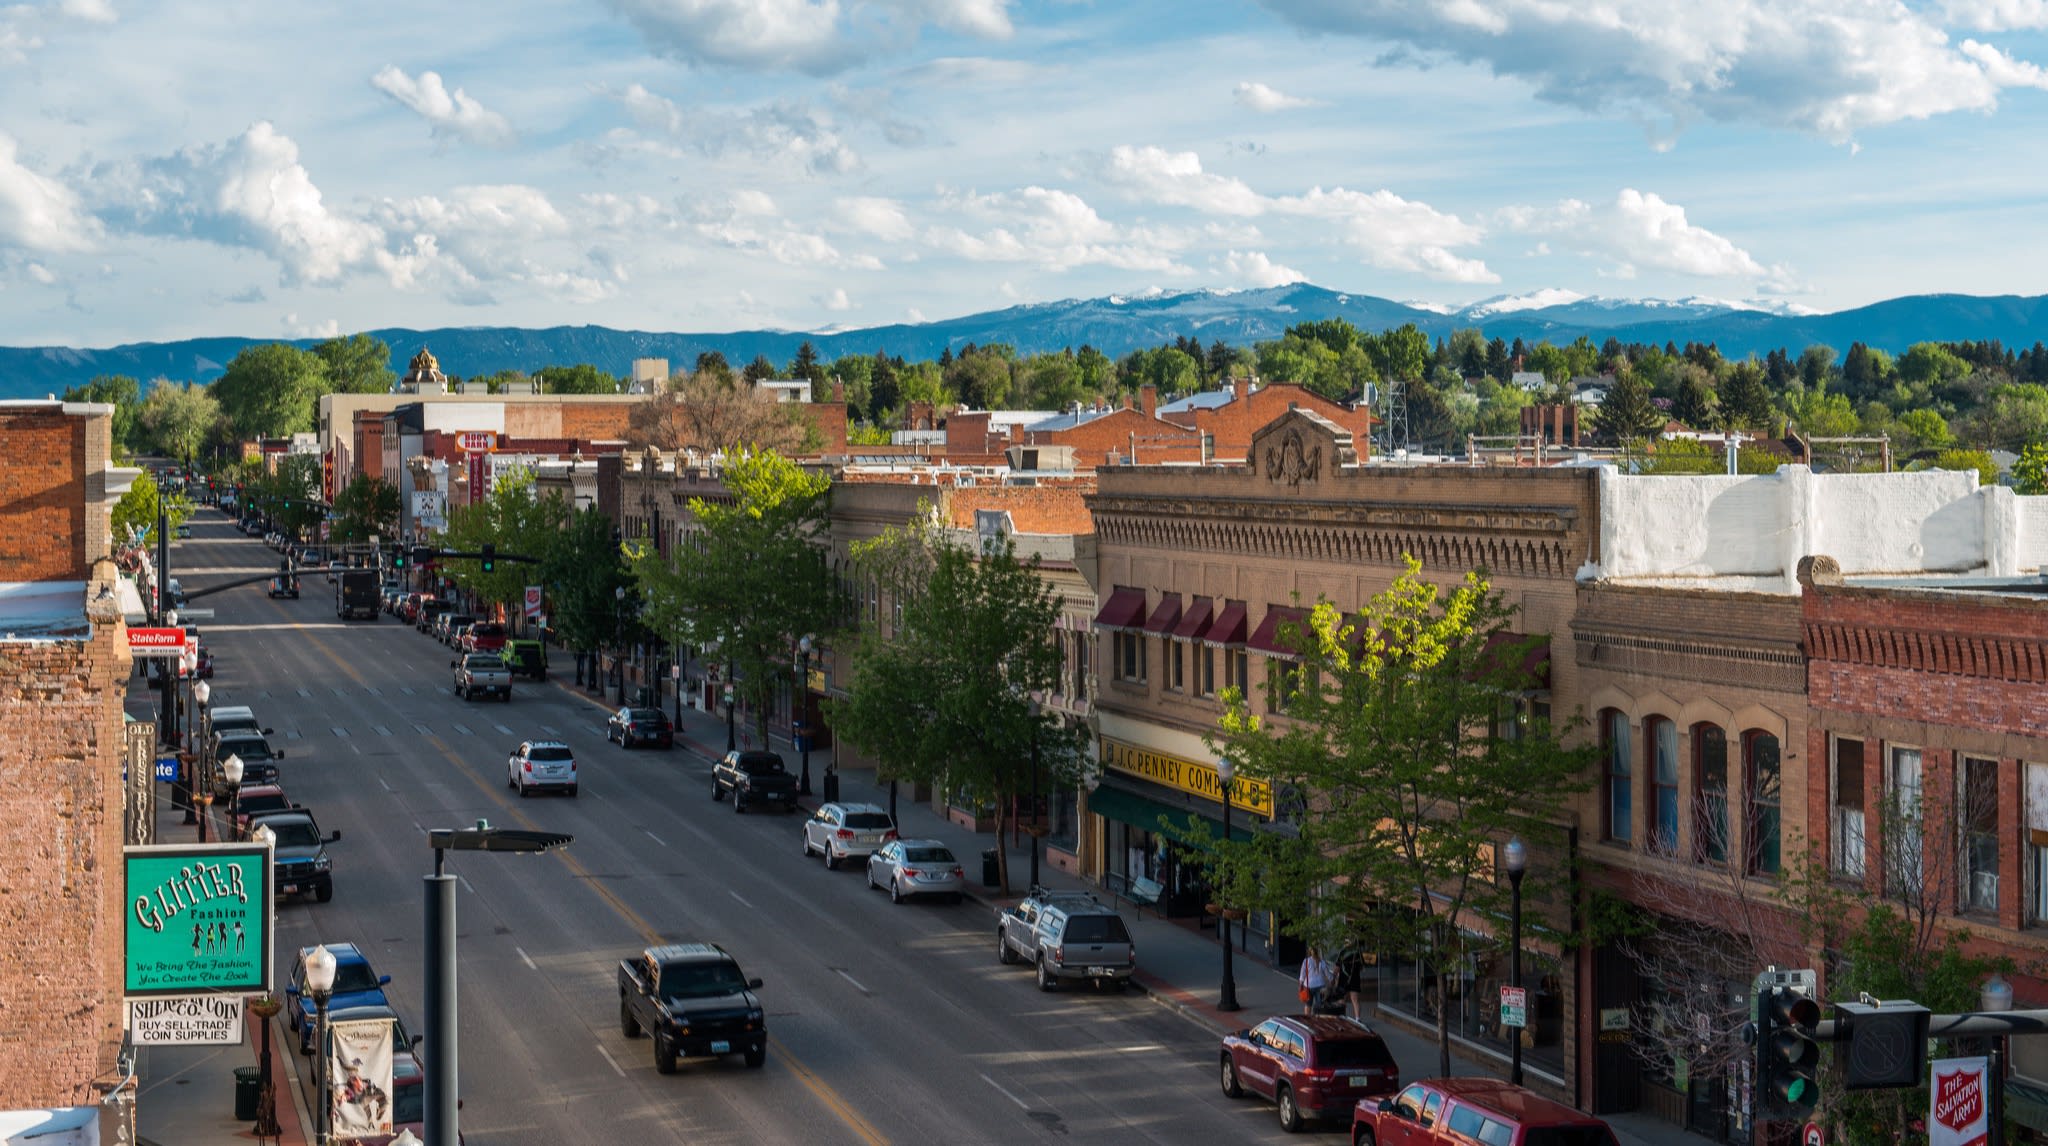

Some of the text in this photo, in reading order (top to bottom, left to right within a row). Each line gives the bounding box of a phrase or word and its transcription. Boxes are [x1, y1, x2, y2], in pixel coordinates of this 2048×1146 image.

[464, 433, 489, 442] BOOT
[464, 441, 489, 449] BARN
[325, 462, 334, 496] WYO
[128, 723, 155, 736] OLD
[135, 861, 248, 933] GLITTER
[190, 908, 246, 919] Fashion
[136, 962, 152, 971] We
[155, 961, 183, 973] Bring
[187, 960, 208, 970] The
[138, 970, 249, 986] You Create The Look
[176, 1003, 201, 1017] CO.
[206, 996, 240, 1019] COIN
[139, 1020, 232, 1031] BUY-SELL-TRADE
[143, 1030, 228, 1041] COIN SUPPLIES
[1944, 1074, 1963, 1096] THE
[1937, 1075, 1979, 1120] SALVATION
[1952, 1094, 1978, 1127] ARMY
